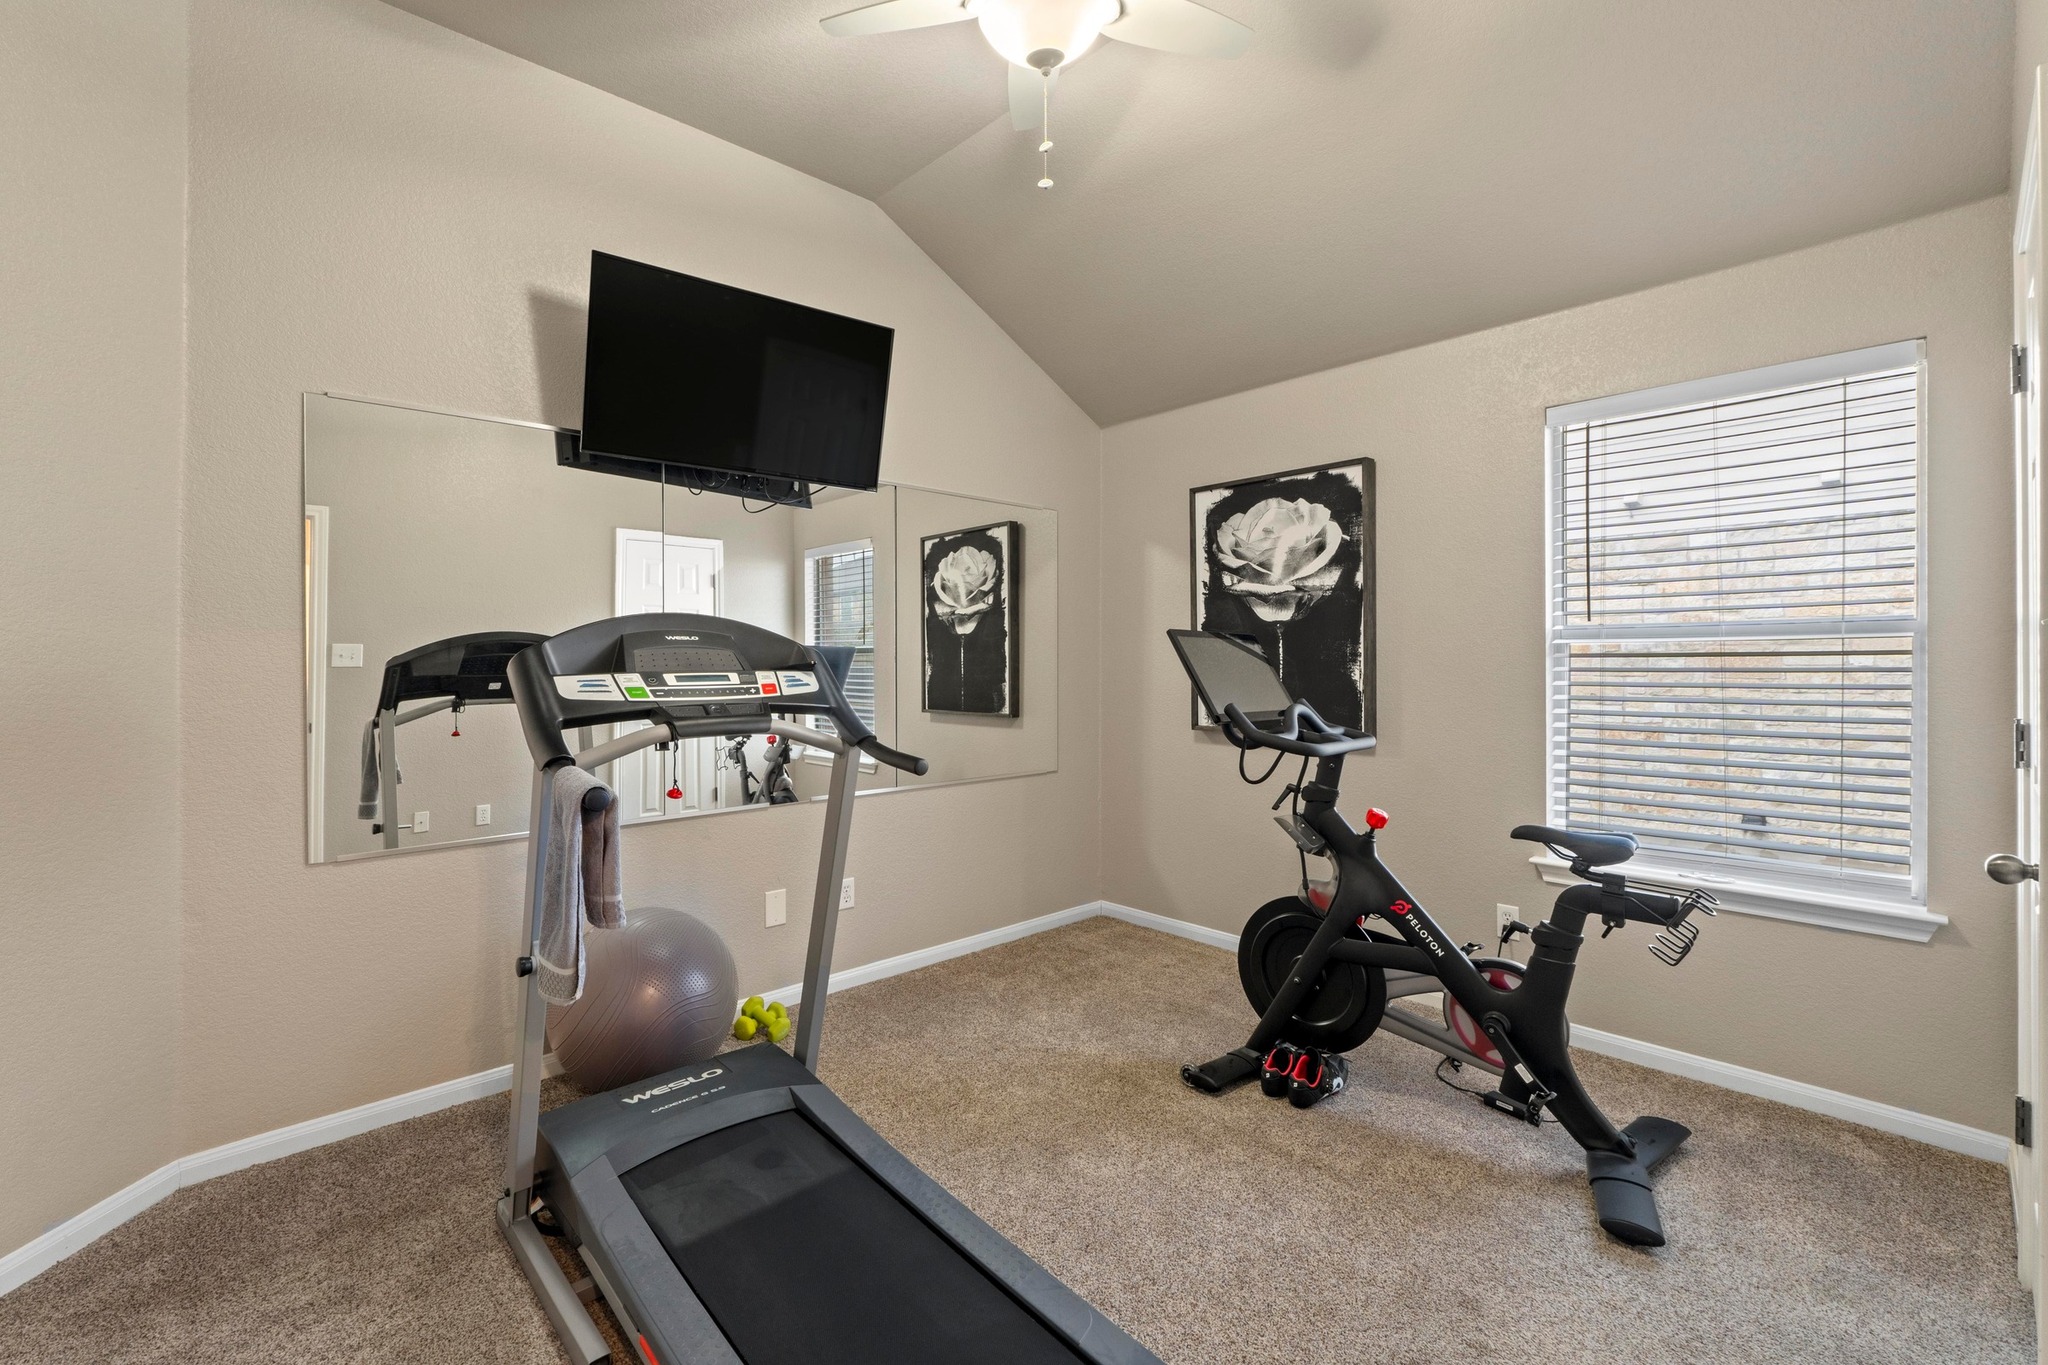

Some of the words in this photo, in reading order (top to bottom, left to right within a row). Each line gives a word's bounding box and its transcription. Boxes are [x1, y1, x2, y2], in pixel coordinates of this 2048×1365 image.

[1405, 913, 1445, 957] PELOTON
[621, 1068, 724, 1104] WESLO
[651, 1095, 699, 1114] CADENCE
